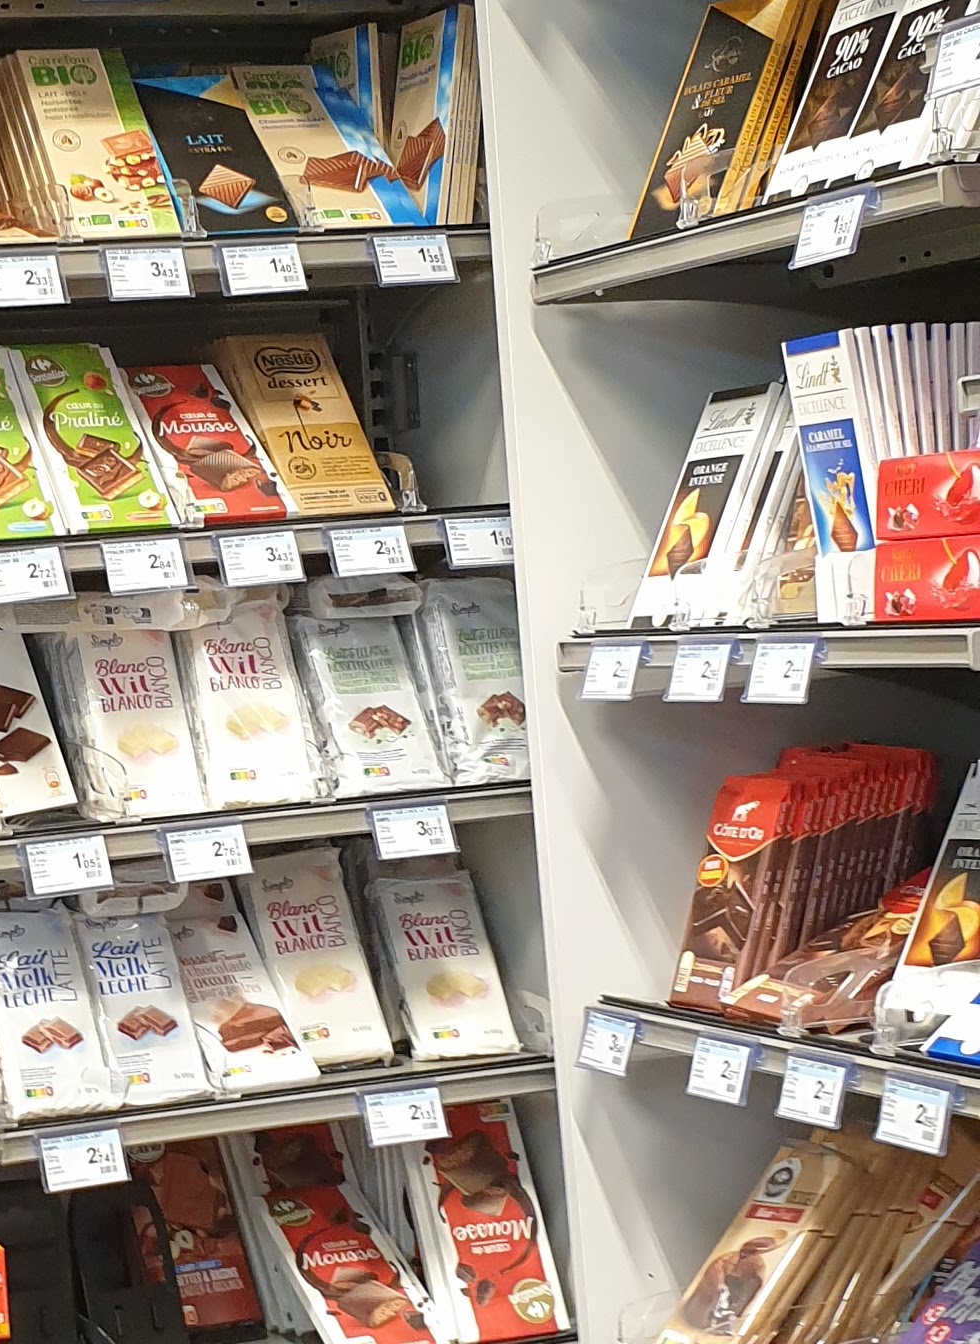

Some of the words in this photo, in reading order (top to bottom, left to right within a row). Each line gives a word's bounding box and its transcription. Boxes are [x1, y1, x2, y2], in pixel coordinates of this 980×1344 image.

[833, 27, 874, 65] 90%
[31, 64, 98, 87] BIO
[826, 57, 863, 80] CACAO
[185, 133, 225, 147] LAIT
[267, 375, 329, 390] dessert
[795, 362, 830, 390] Lindt
[50, 410, 124, 431] Praliné
[158, 420, 239, 437] Mousse
[278, 428, 353, 453] Noir
[808, 427, 845, 443] CARAMEL
[687, 473, 725, 487] INTENSE
[692, 462, 729, 476] ORANGE
[202, 636, 254, 656] Blanc
[95, 658, 148, 677] Blanc
[252, 636, 283, 690] BIANCO
[146, 656, 174, 709] BIANCO
[209, 675, 261, 692] BLANCO
[101, 694, 153, 713] BLANCO
[267, 899, 318, 920] Blanc
[399, 911, 450, 930] Blanc
[315, 894, 348, 949] BIANCO
[448, 908, 480, 957] BIANCO
[91, 939, 142, 959] Lait
[275, 934, 326, 956] BLANCO
[407, 943, 459, 962] BLANCO
[94, 956, 150, 980] Melk
[142, 936, 173, 990] LATTE
[0, 966, 56, 992] Melk
[48, 947, 79, 1003] LATTE
[98, 975, 152, 997] LECHE
[2, 988, 56, 1009] LECHE
[453, 1216, 534, 1242] Mousse
[300, 1247, 381, 1271] Mousse
